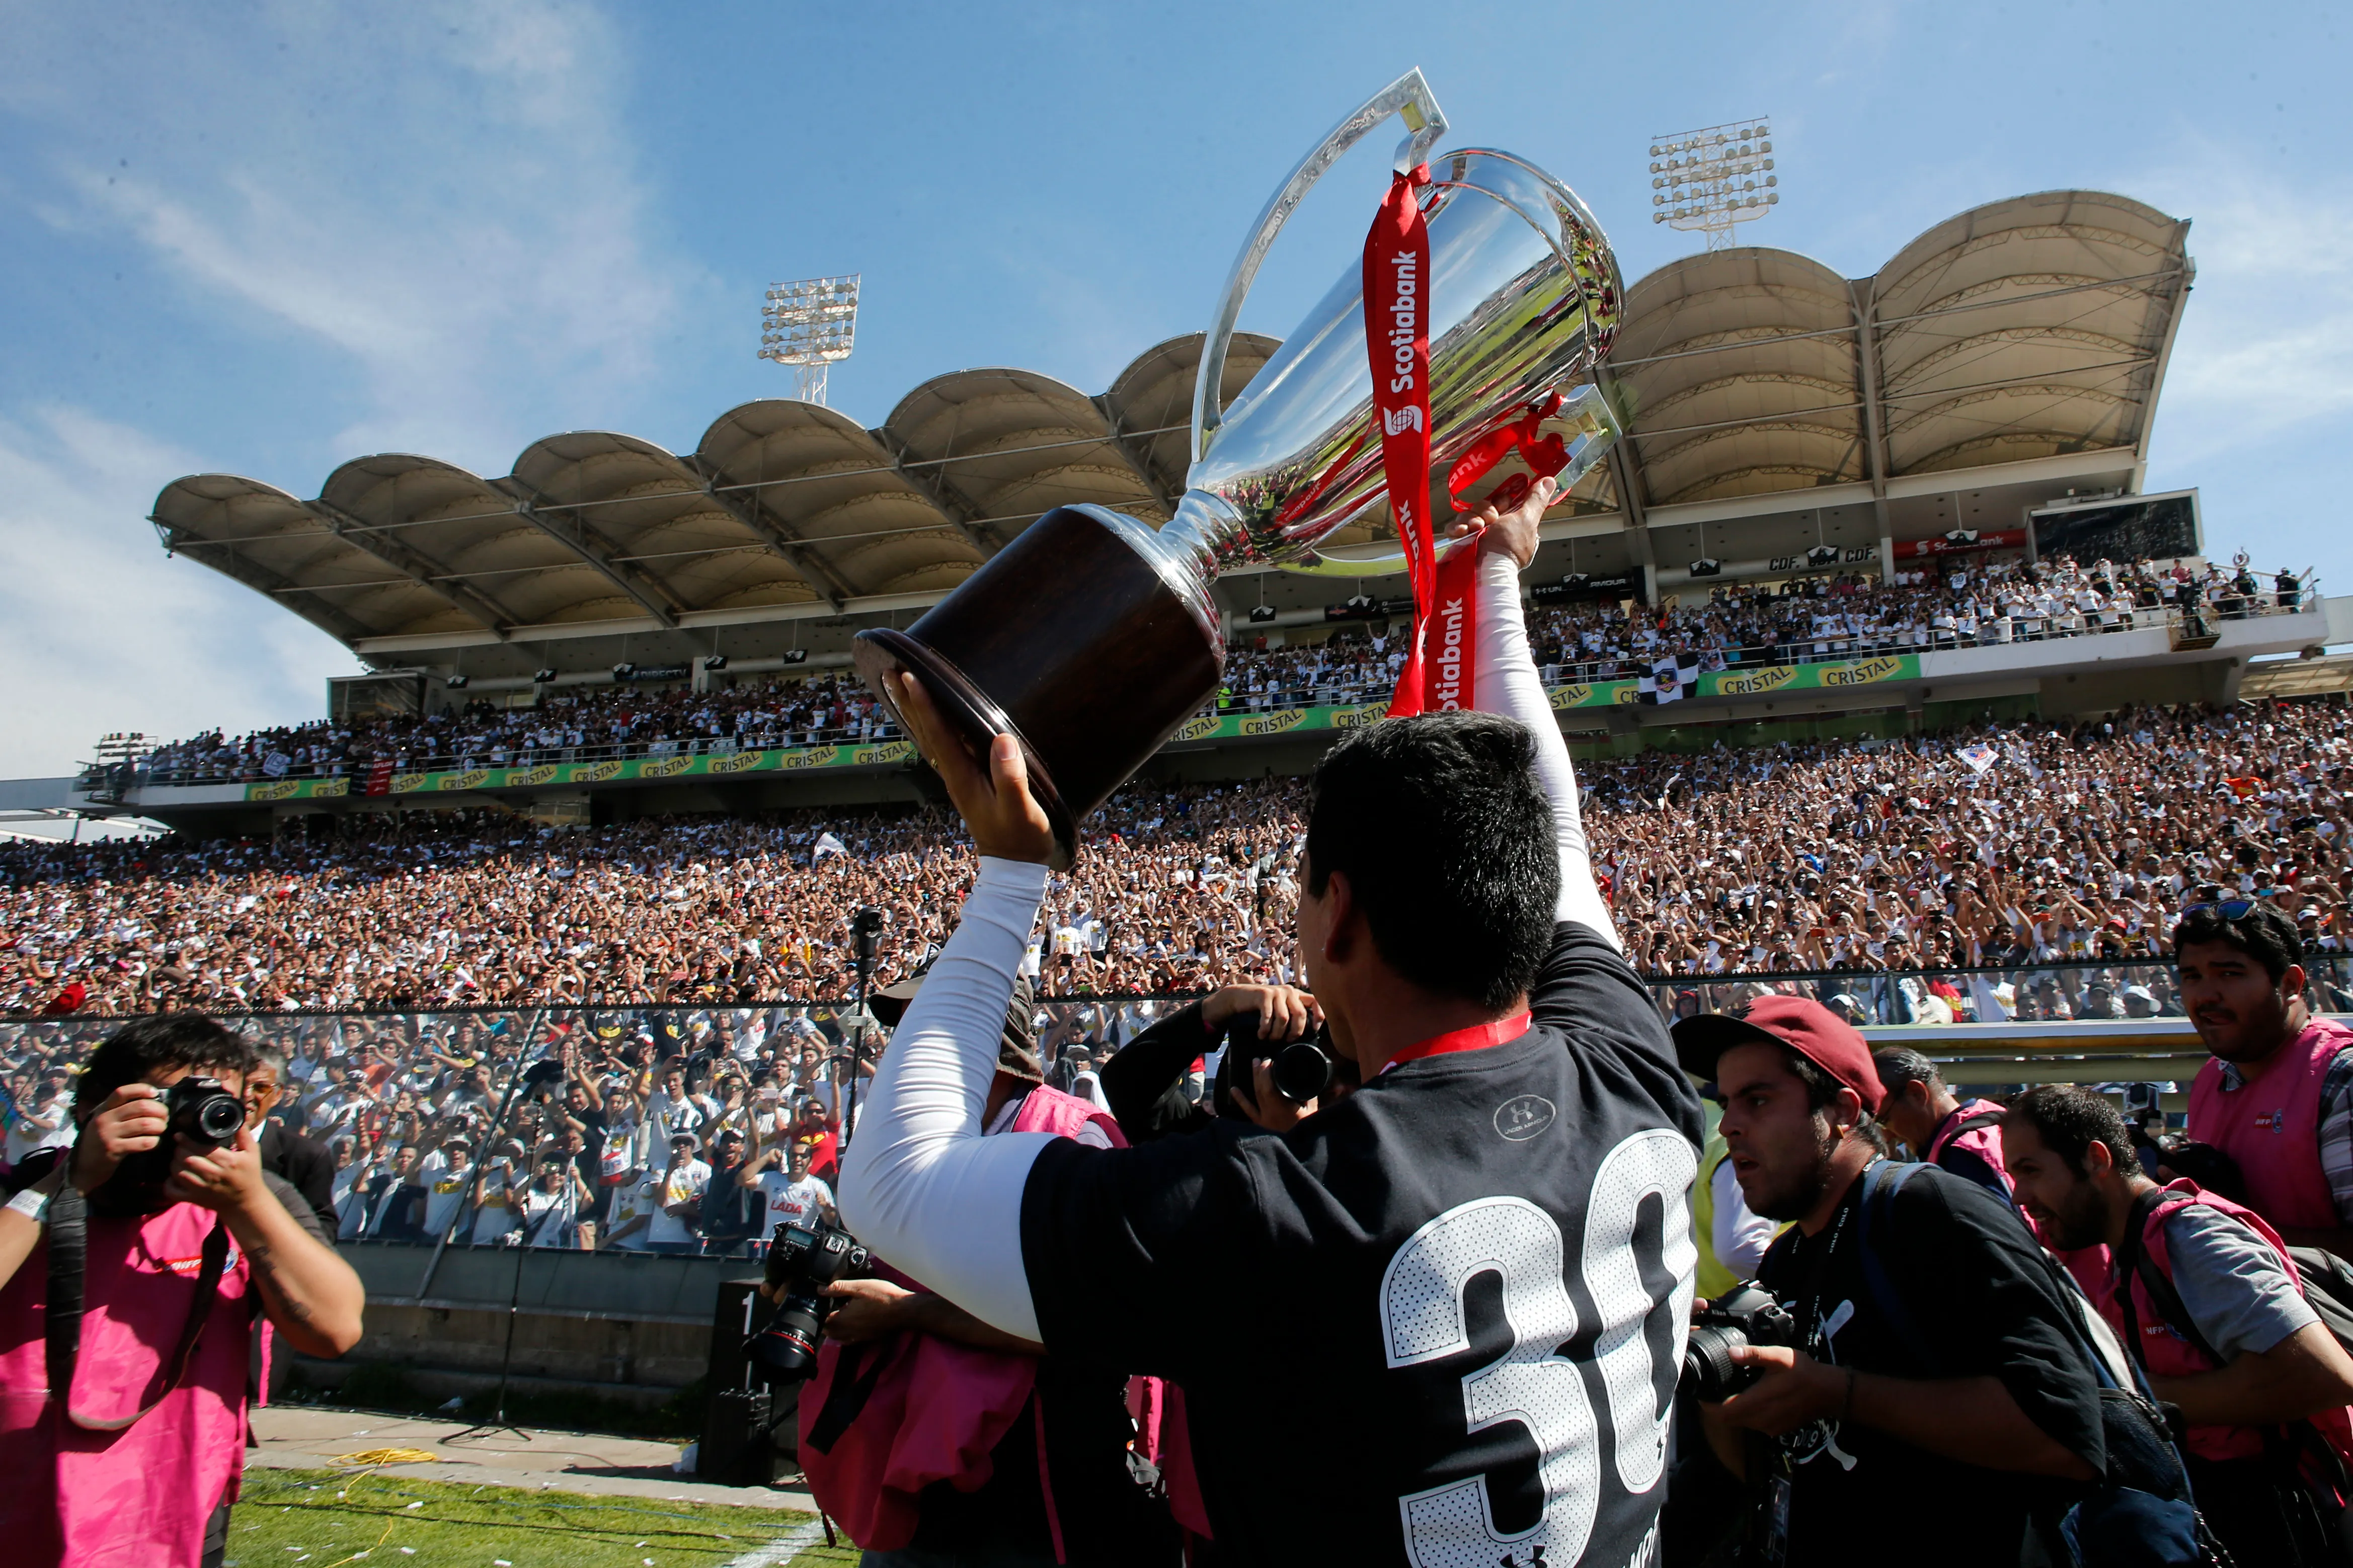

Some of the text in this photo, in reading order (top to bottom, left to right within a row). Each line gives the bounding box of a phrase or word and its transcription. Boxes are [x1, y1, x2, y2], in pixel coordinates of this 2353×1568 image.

[1388, 251, 1416, 393] Scotiabank
[1934, 536, 2004, 551] Scank
[1435, 597, 1463, 711] otiabank
[1724, 667, 1790, 694] CRISTAL
[1827, 657, 1895, 685] CRISTAL
[1550, 686, 1587, 708] STAL
[1172, 716, 1218, 741] RISTAL
[1245, 709, 1302, 734] CRISTAL
[713, 752, 760, 773] CRISTAL
[787, 747, 835, 769] CRISTAL
[858, 742, 908, 764] CRISTAL
[511, 764, 555, 786] CRISTAL
[575, 762, 620, 782] CRISTAL
[645, 757, 691, 777] CRISTAL
[255, 781, 298, 800] CRISTAL
[389, 774, 426, 793] RISTAL
[443, 770, 487, 790] CRISTAL
[1505, 1114, 1549, 1134] UNDER ARMOUR
[770, 1200, 803, 1215] LADA
[1380, 1128, 1698, 1568] 30
